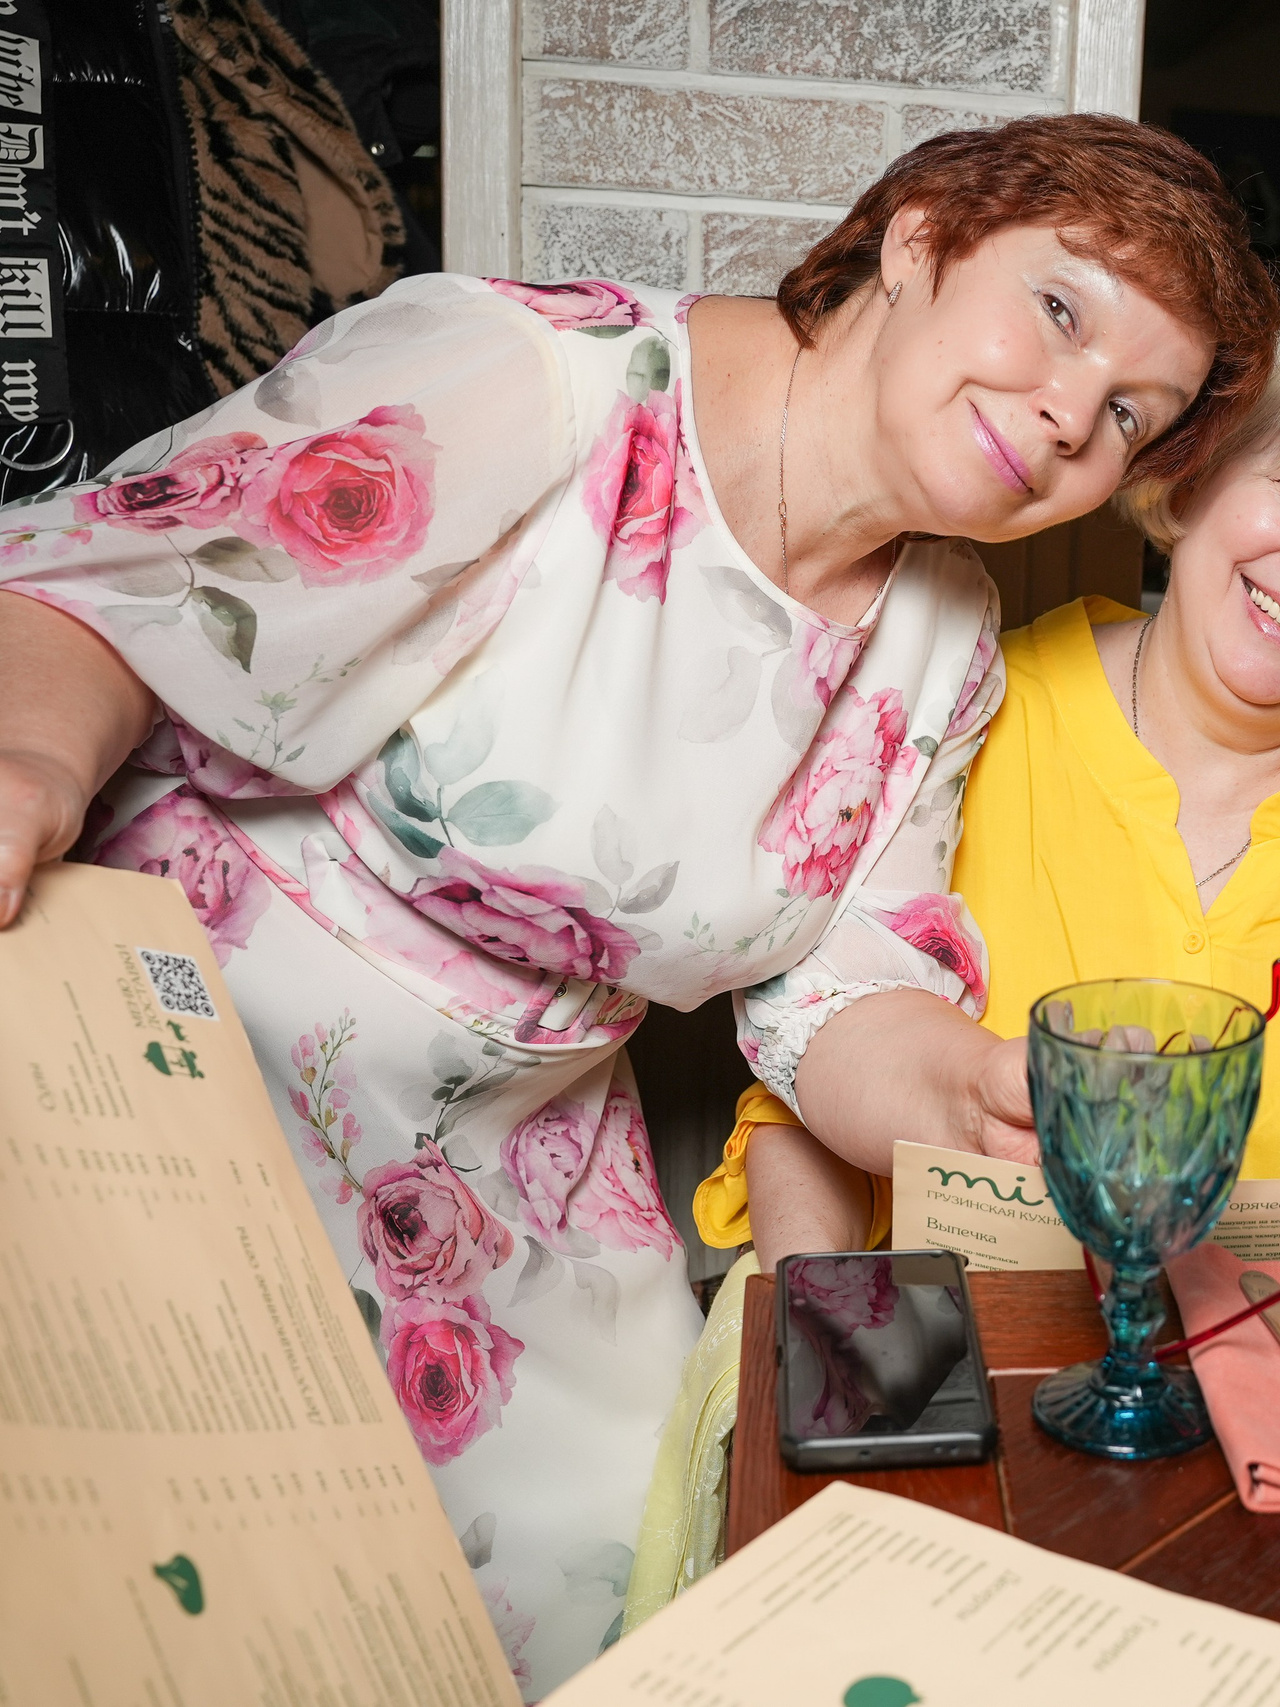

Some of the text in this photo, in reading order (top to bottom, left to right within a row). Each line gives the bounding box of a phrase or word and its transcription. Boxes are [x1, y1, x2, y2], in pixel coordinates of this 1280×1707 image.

[0, 260, 46, 336] kill
[114, 943, 164, 1032] ДОСТАВКИ
[928, 1166, 1052, 1206] mi
[927, 1190, 1066, 1227] ГРУЗИНСКАЯ КУХНЯ
[925, 1238, 961, 1251] Хачапури
[927, 1216, 997, 1244] Выпечка
